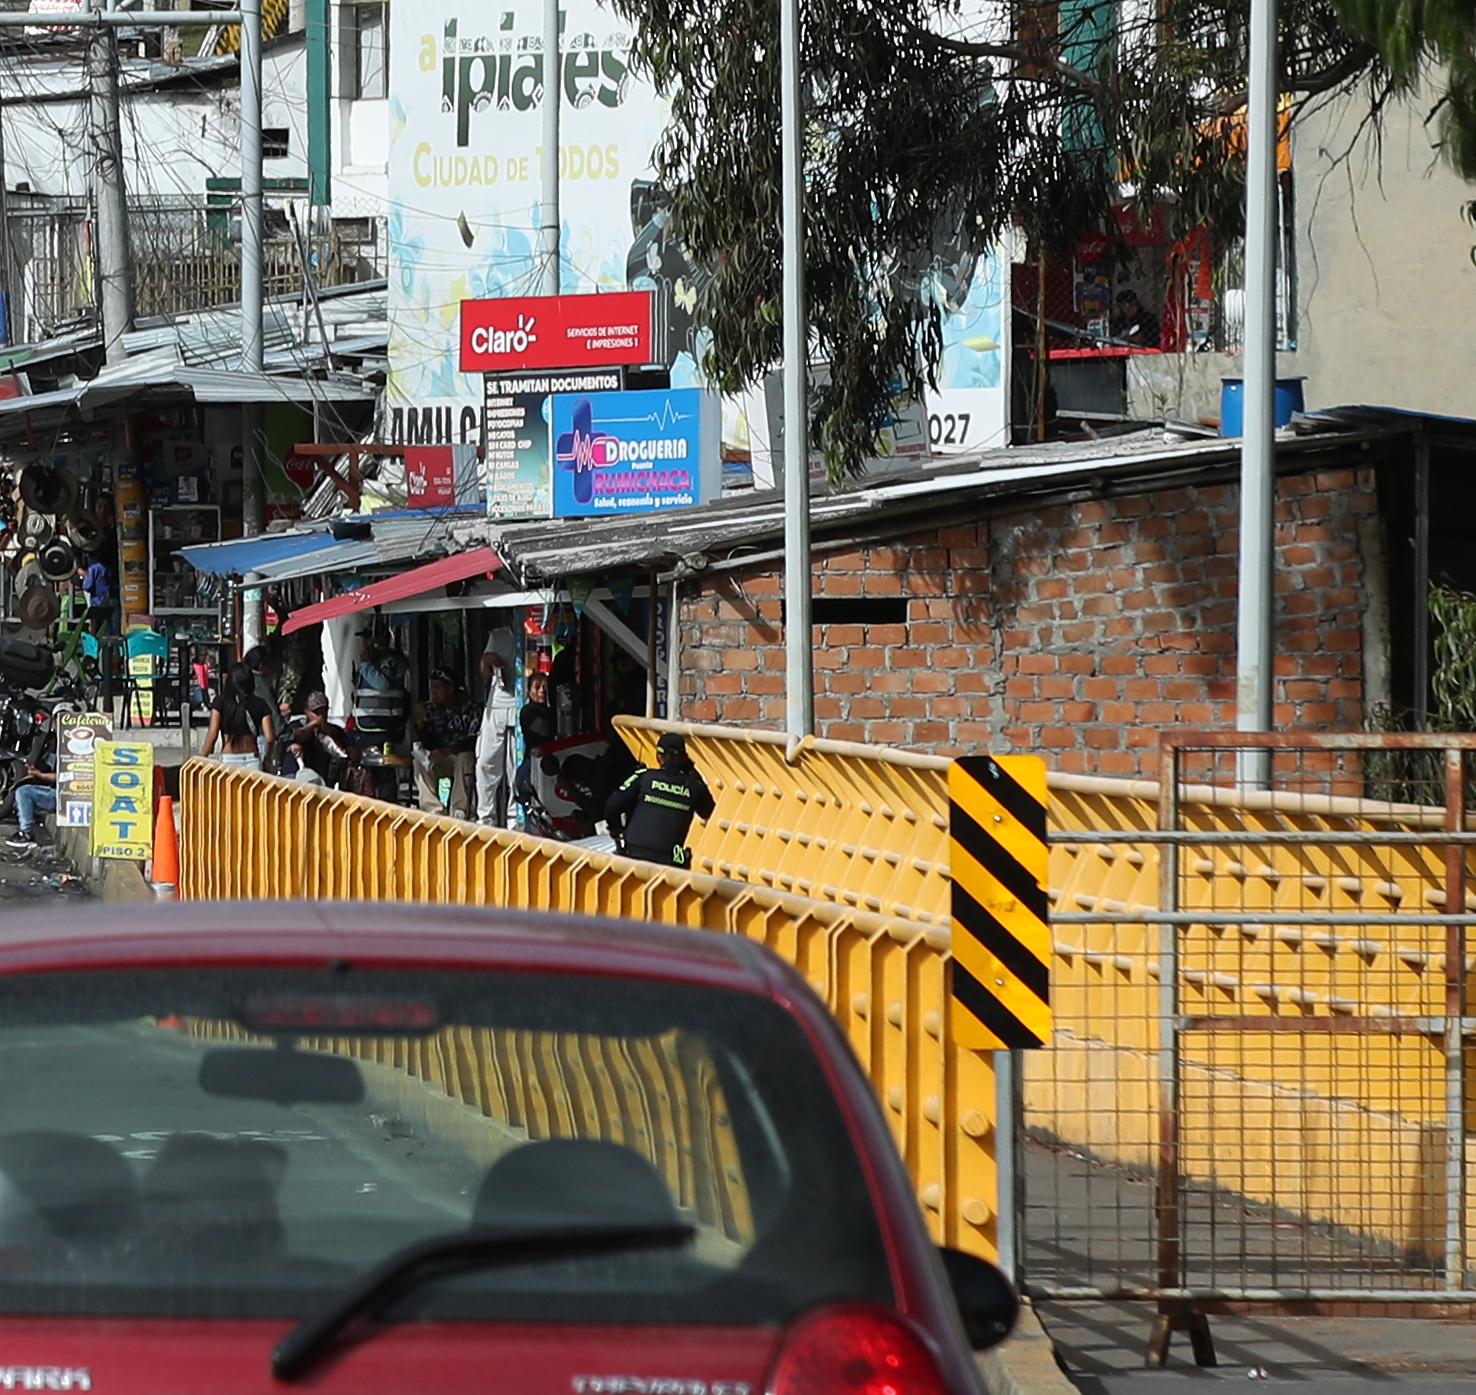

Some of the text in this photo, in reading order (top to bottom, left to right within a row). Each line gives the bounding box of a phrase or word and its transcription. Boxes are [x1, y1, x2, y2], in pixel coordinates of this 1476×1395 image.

[471, 325, 529, 354] Claro
[567, 327, 598, 338] SERVICIOS
[607, 325, 639, 337] INTERNET
[499, 378, 549, 394] TRAMITAN
[551, 376, 618, 391] DOCUMENTOS
[929, 413, 971, 445] 027
[606, 437, 688, 461] DROGUERIA
[594, 469, 692, 494] RUMICHACA
[109, 747, 140, 839] SOAT
[651, 780, 691, 798] POLICÍA
[103, 846, 146, 857] PISO 2
